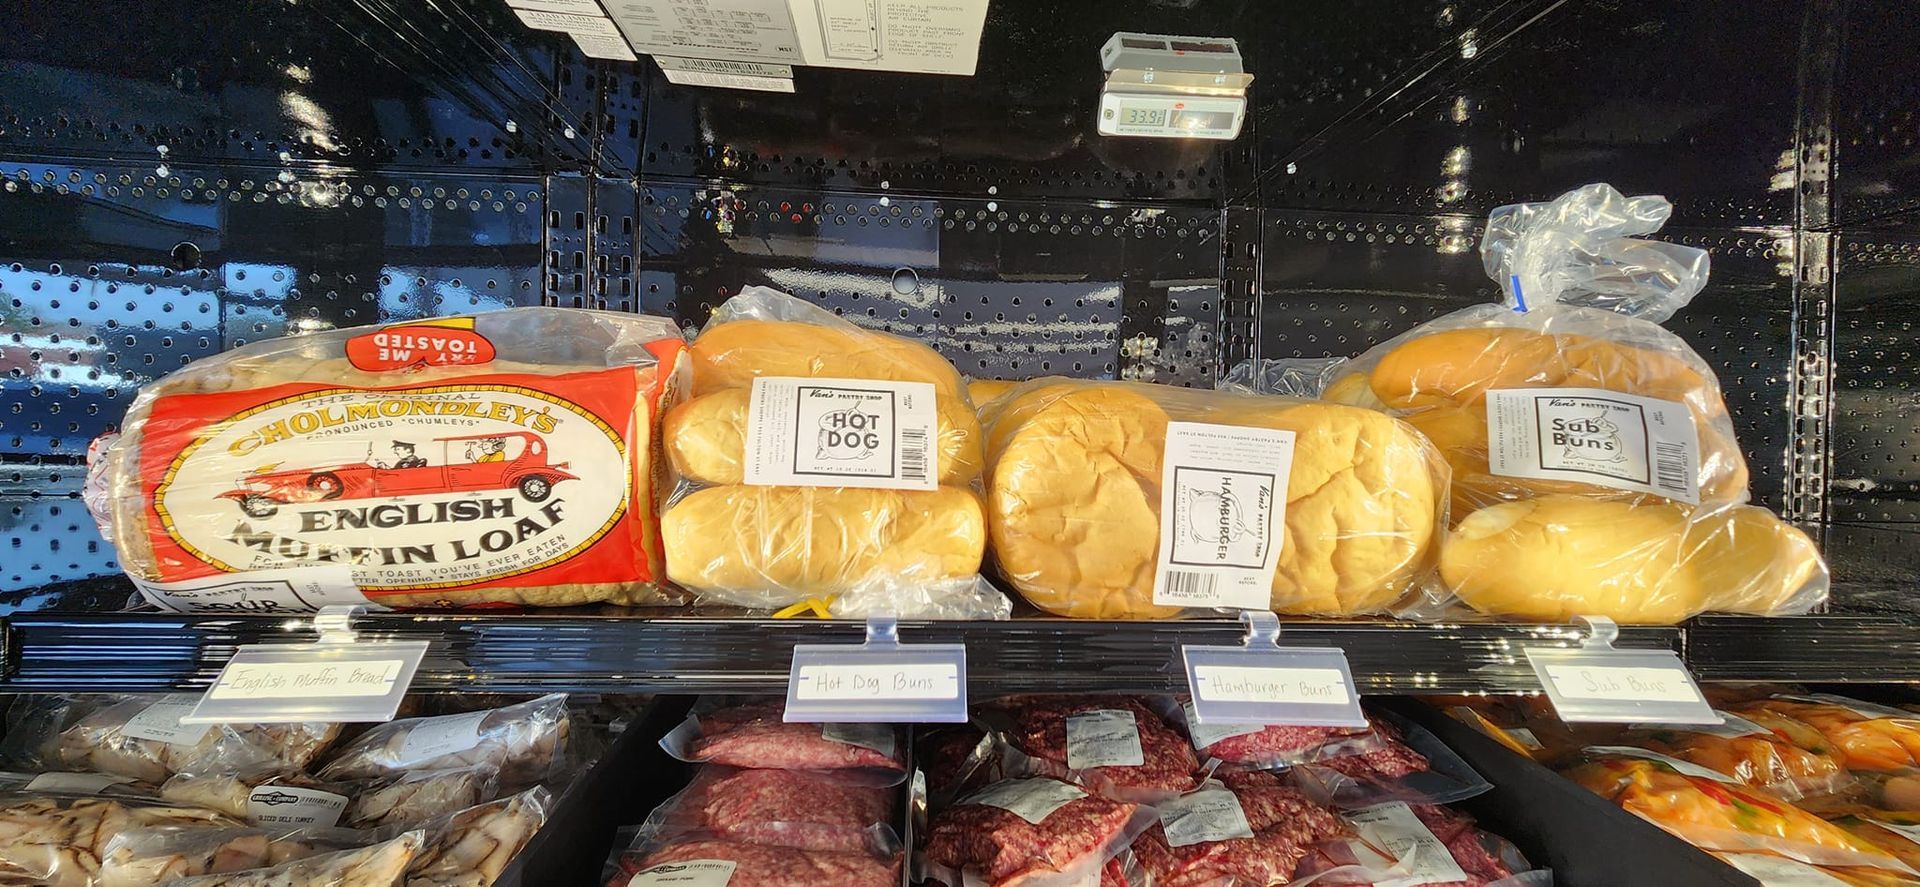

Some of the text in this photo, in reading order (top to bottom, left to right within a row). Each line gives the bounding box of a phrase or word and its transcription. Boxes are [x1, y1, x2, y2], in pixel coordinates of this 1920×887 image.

[373, 333, 477, 354] TOASTED
[378, 348, 476, 363] TRY ME
[302, 393, 481, 408] THE ORIGINAL
[810, 389, 834, 398] Van's
[1549, 398, 1576, 407] Van's
[227, 399, 558, 456] CHOLMONDLEY'S
[306, 418, 393, 440] PRONOUNCED
[832, 412, 880, 430] HOT
[1551, 418, 1600, 433] Sub
[827, 430, 880, 450] DOG
[1552, 432, 1614, 451] Buns
[1258, 484, 1270, 510] Van's
[299, 497, 515, 533] ENGLISH
[1216, 477, 1232, 561] HAMBURGER
[224, 498, 566, 565] MUFFIN LOAF
[376, 569, 422, 578] TOAST
[430, 562, 481, 575] YOU'VE
[488, 553, 521, 567] EVER
[526, 534, 566, 556] EATEN
[385, 576, 433, 584] OPENING
[450, 571, 482, 580] STAYS
[486, 564, 518, 575] FRESH
[523, 556, 542, 566] FOR
[544, 542, 570, 557] DAYS
[188, 600, 279, 611] SOUR
[230, 664, 390, 690] English Muffin Bread
[816, 671, 935, 695] Hot Dog Buns
[1212, 676, 1333, 699] Hamburger Buns
[1580, 670, 1667, 693] Sub Buns
